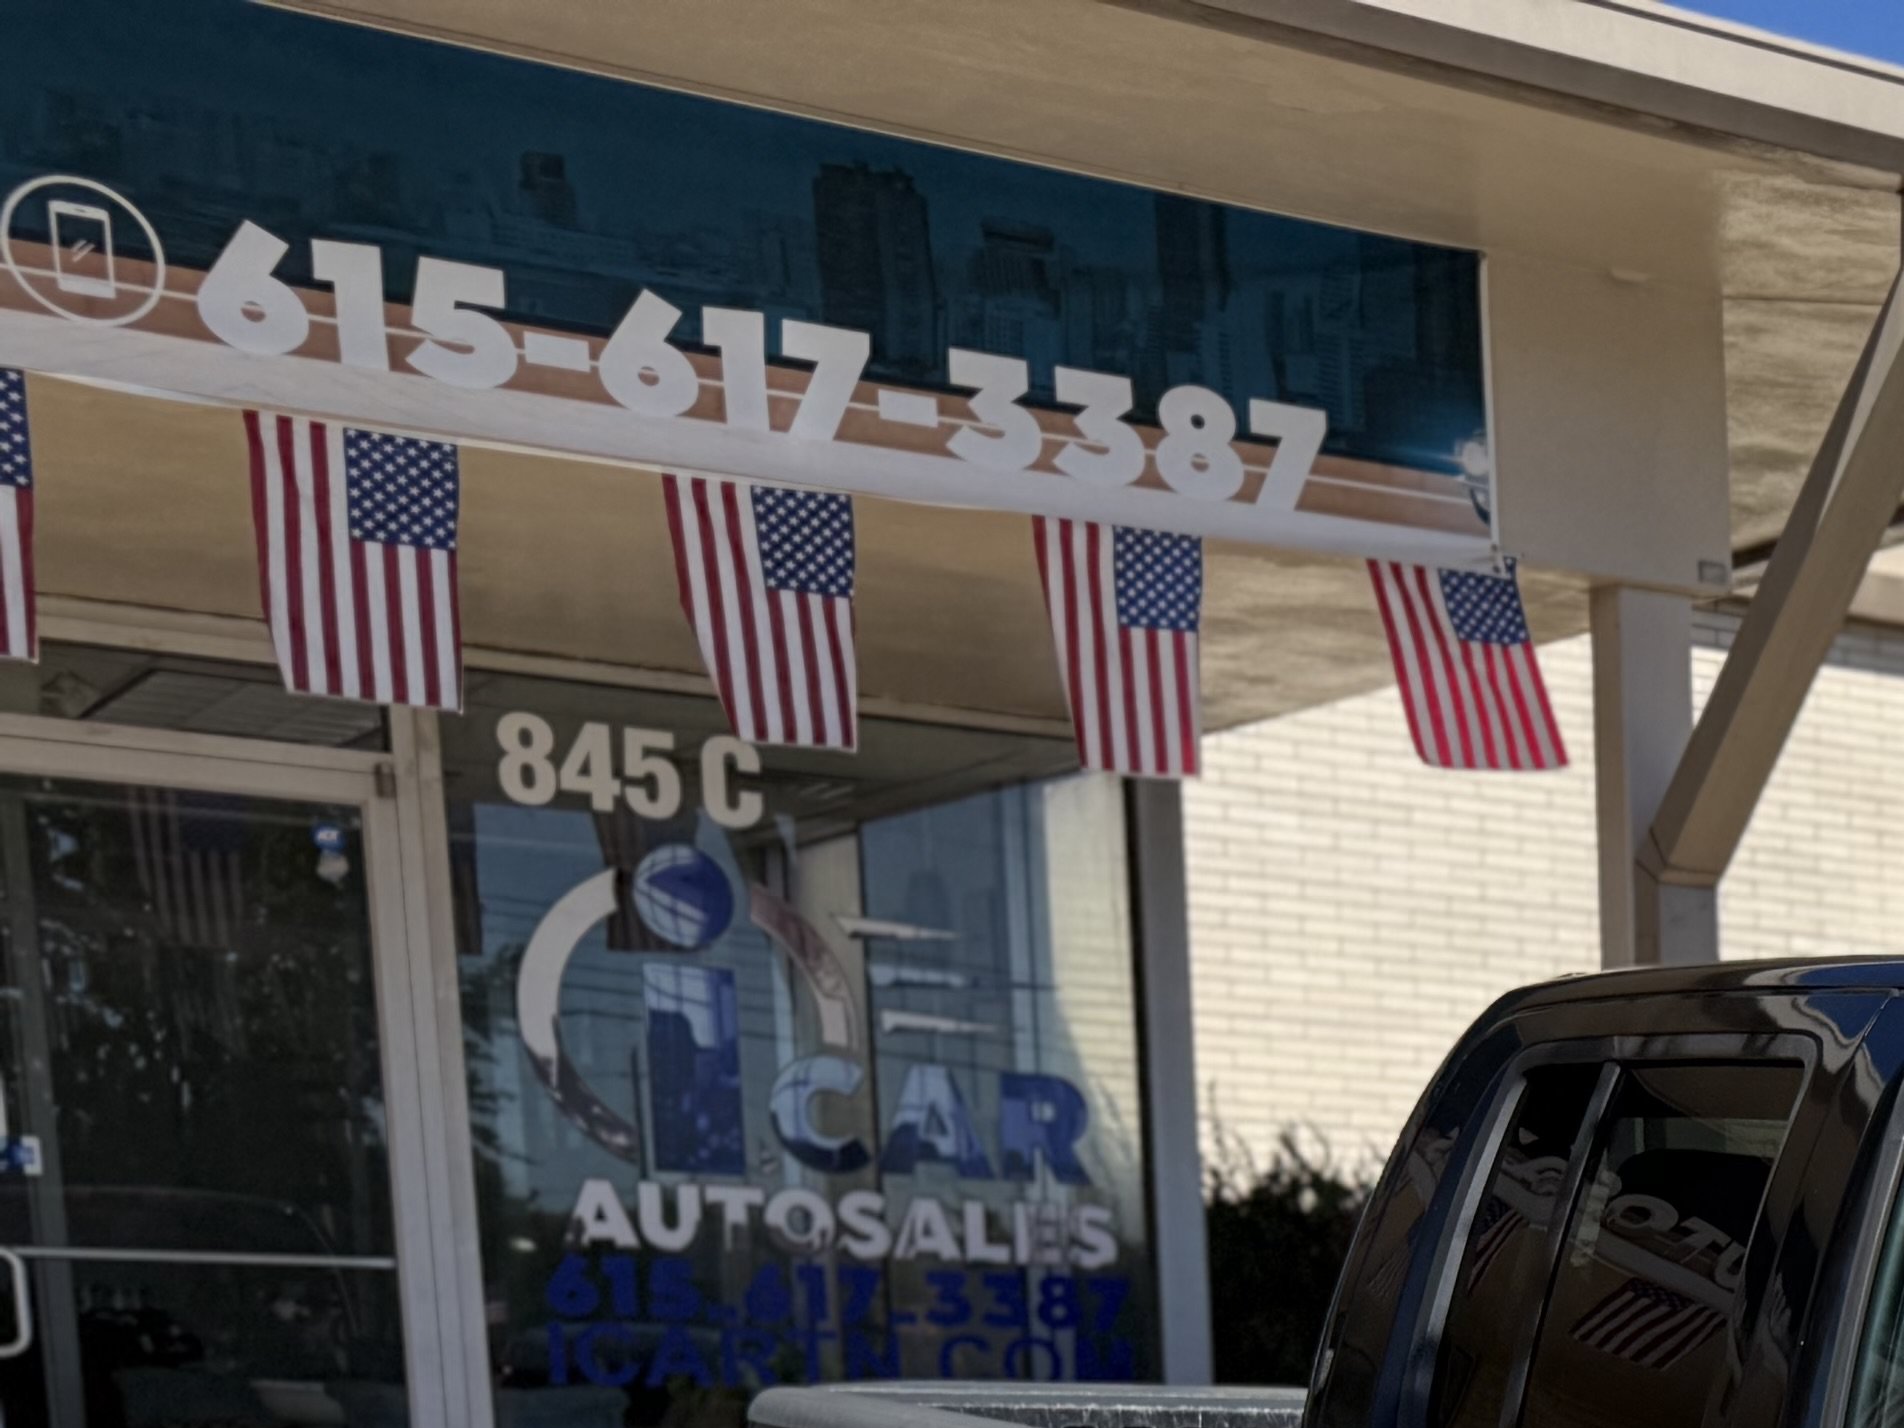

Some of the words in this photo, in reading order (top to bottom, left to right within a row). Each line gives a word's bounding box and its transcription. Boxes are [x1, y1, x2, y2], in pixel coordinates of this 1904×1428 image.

[197, 219, 1327, 512] 615-617-3387
[496, 711, 682, 820] 845
[700, 733, 764, 828] C
[568, 1179, 1119, 1268] AUTOSALES
